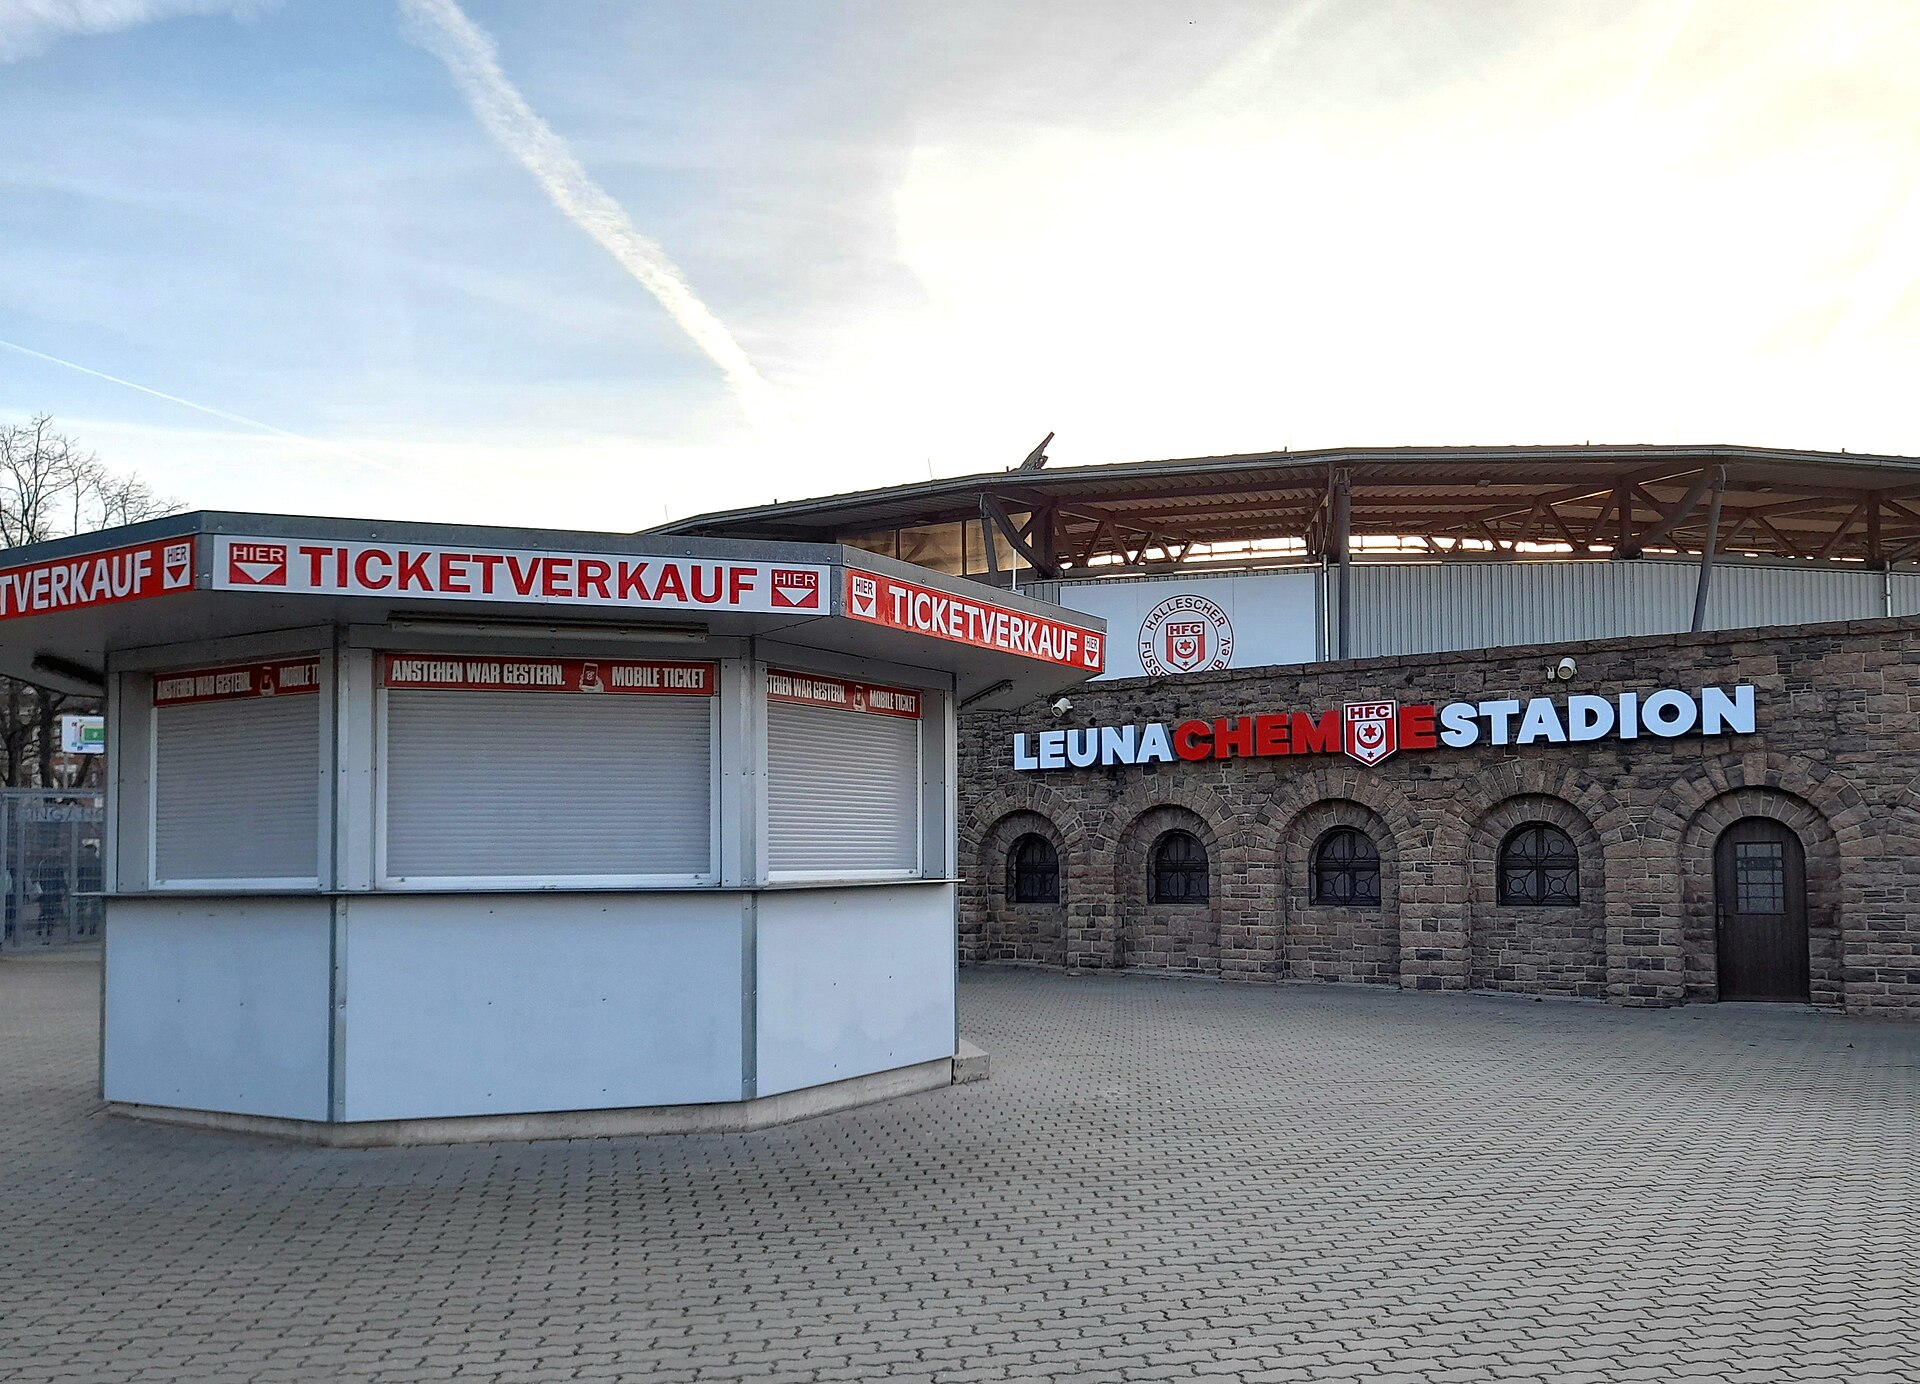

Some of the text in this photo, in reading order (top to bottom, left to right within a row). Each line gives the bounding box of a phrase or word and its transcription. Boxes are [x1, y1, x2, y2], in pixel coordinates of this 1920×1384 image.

[167, 546, 187, 563] HIER
[232, 546, 285, 562] HIER
[298, 546, 758, 604] TICKETVERKAUF
[774, 573, 816, 587] HIER
[855, 578, 874, 596] HIER
[888, 585, 1078, 661] TICKETVERKAUF
[1145, 598, 1226, 630] HALLESCHER
[1169, 625, 1202, 635] HFC
[1086, 637, 1098, 650] HIER
[391, 660, 566, 686] ANSTEHEN WAR GESTERN.
[611, 666, 706, 689] MOBILE TICKET
[793, 677, 813, 698] WAR
[813, 681, 847, 703] GESTERN.
[869, 690, 916, 712] MOBILE TICKET
[1350, 705, 1390, 719] HFC
